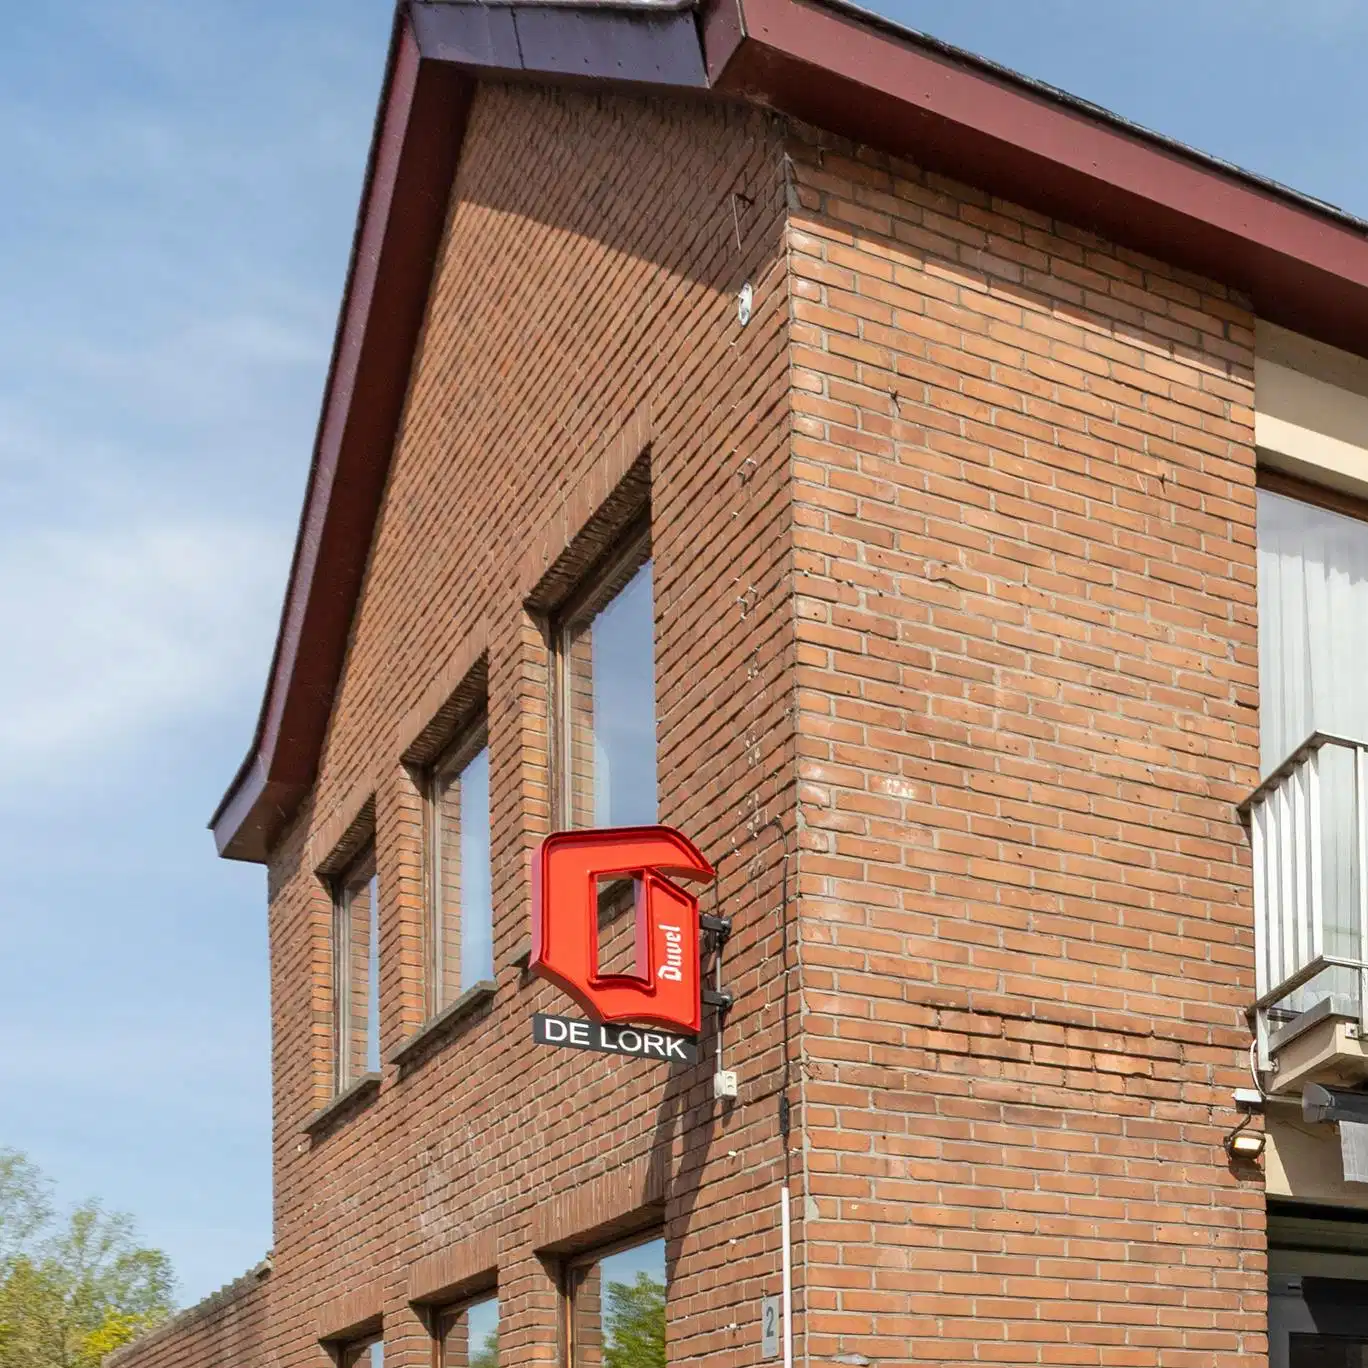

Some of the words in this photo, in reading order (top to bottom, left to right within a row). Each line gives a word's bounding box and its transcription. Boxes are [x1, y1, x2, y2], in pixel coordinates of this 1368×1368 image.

[657, 923, 683, 982] Duvel
[543, 1017, 591, 1046] DE
[599, 1025, 688, 1060] LORK
